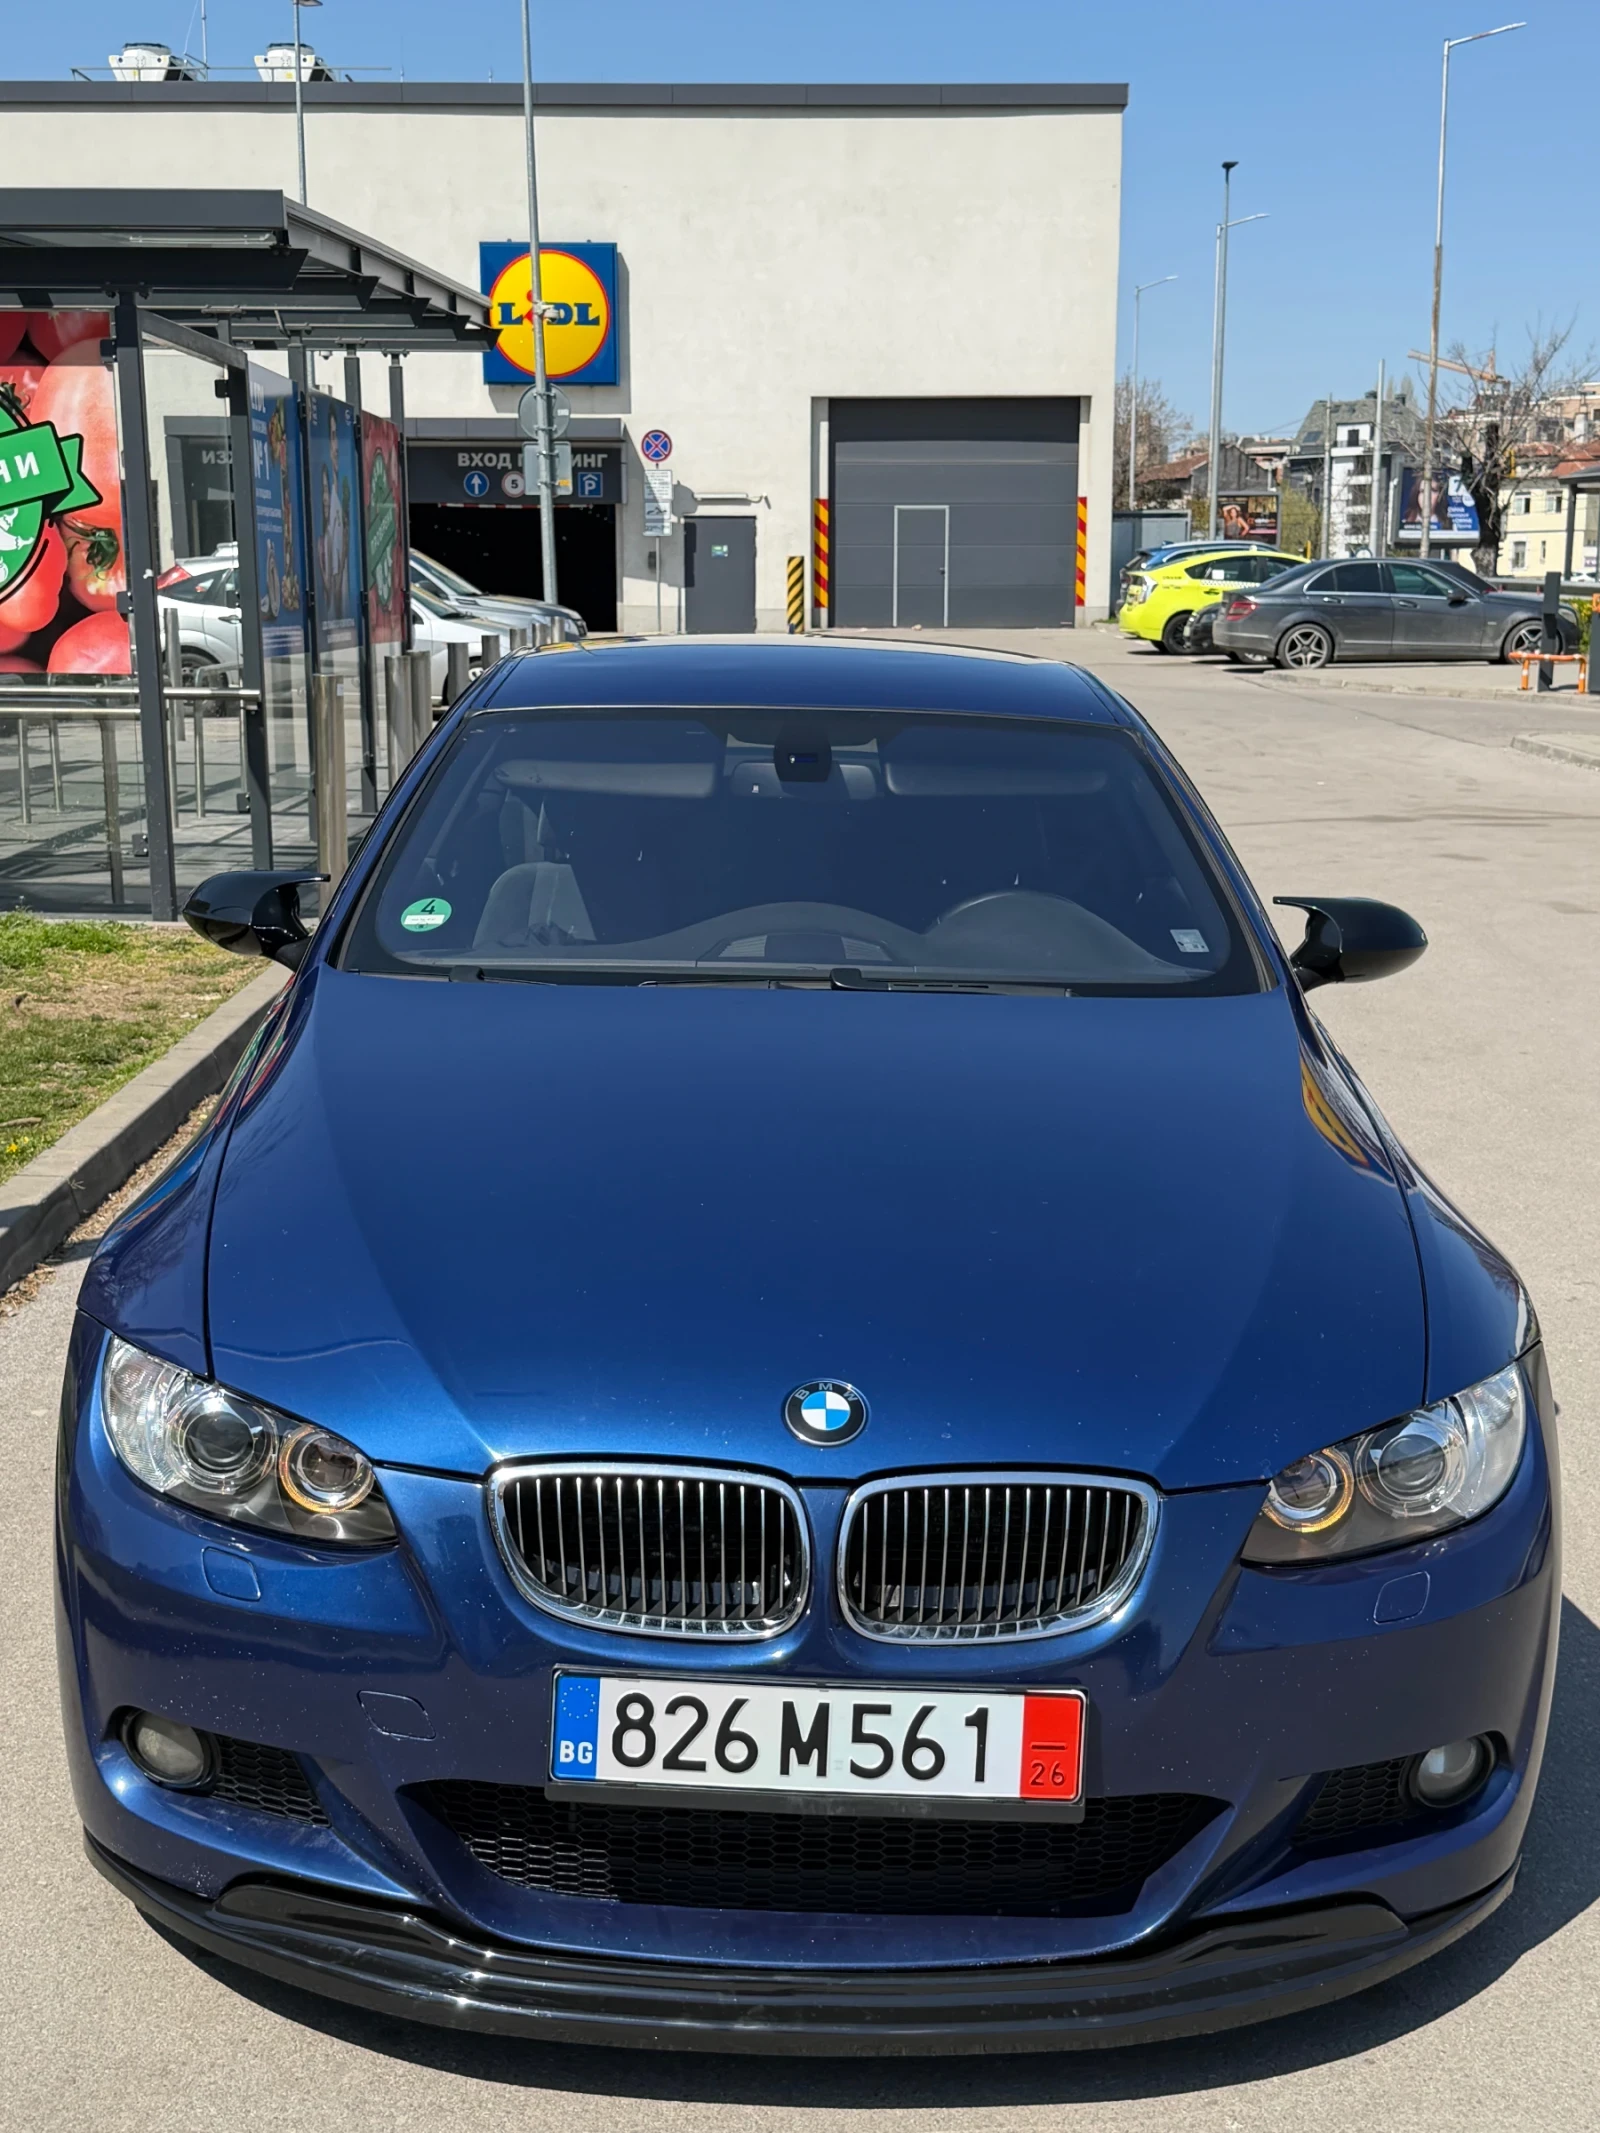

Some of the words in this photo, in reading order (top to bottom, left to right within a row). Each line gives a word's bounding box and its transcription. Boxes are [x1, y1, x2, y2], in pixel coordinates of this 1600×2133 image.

[457, 453, 512, 469] ВХОД
[511, 479, 519, 489] 5
[794, 1382, 858, 1402] BMW
[560, 1740, 594, 1764] BG
[1030, 1762, 1066, 1786] 26
